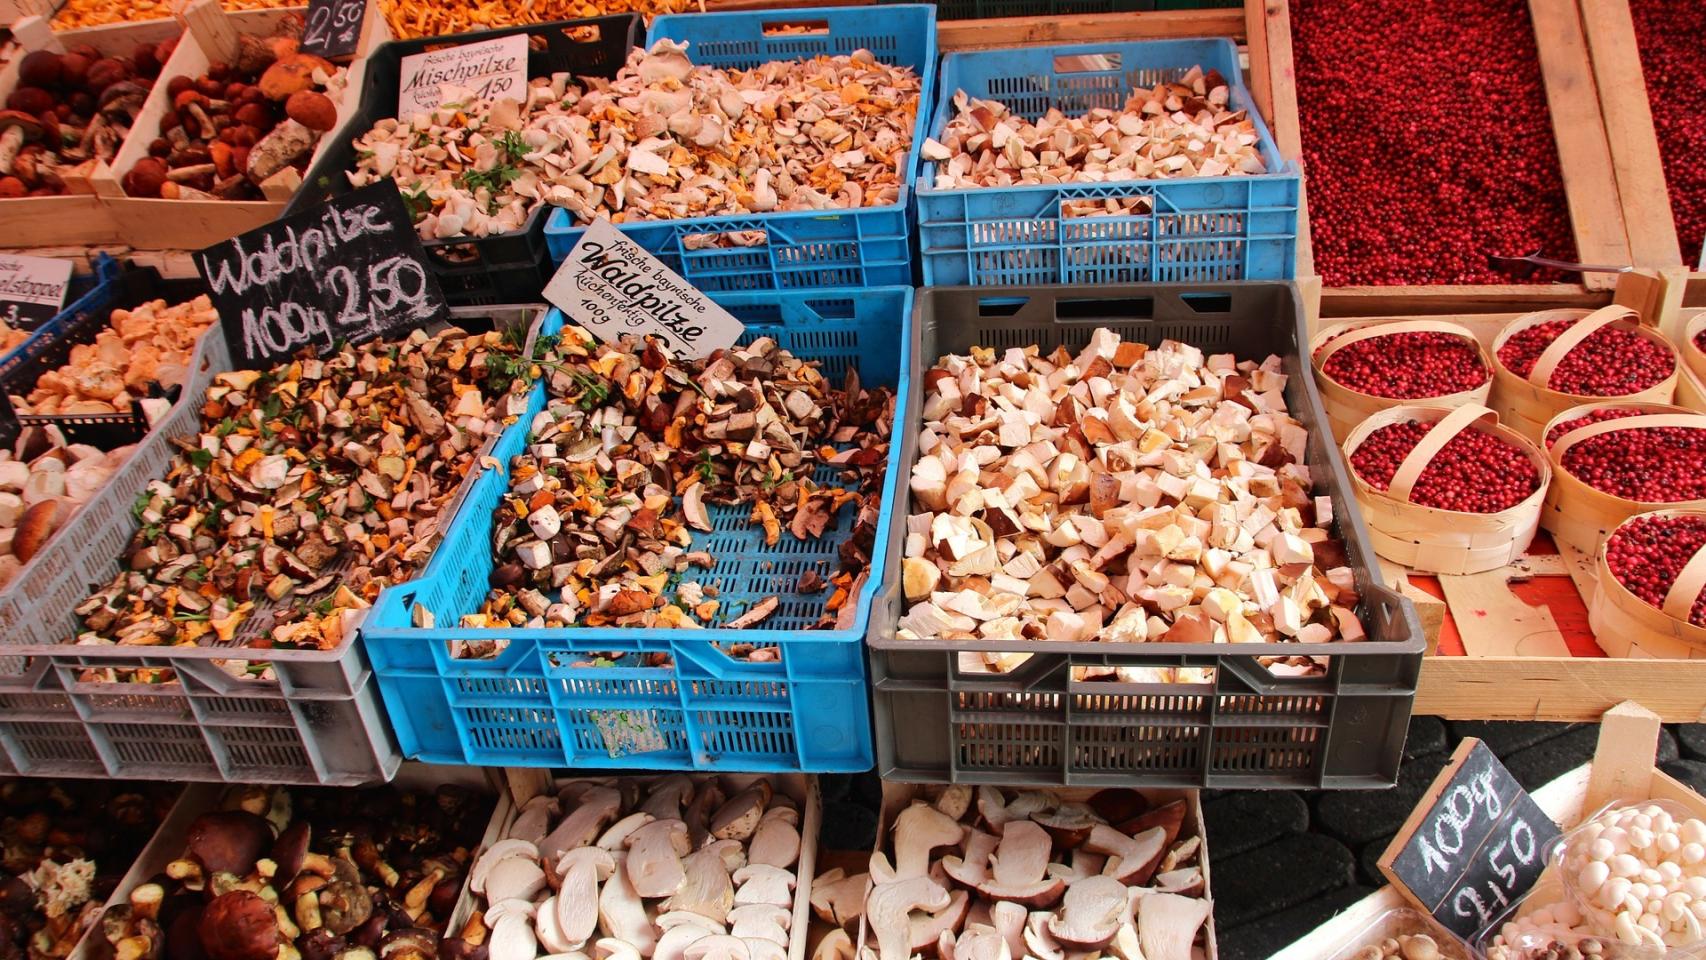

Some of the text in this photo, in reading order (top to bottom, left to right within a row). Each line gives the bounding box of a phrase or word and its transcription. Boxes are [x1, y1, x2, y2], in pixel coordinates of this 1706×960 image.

[402, 55, 516, 94] Mischpilze
[203, 203, 393, 295] Waldpilze
[608, 239, 706, 314] frische bayrische
[242, 256, 427, 359] 100g 2,50
[573, 268, 646, 328] küchenfertig
[580, 298, 612, 325] 100g
[581, 241, 707, 342] Waldpilze
[1418, 764, 1502, 875] 100g
